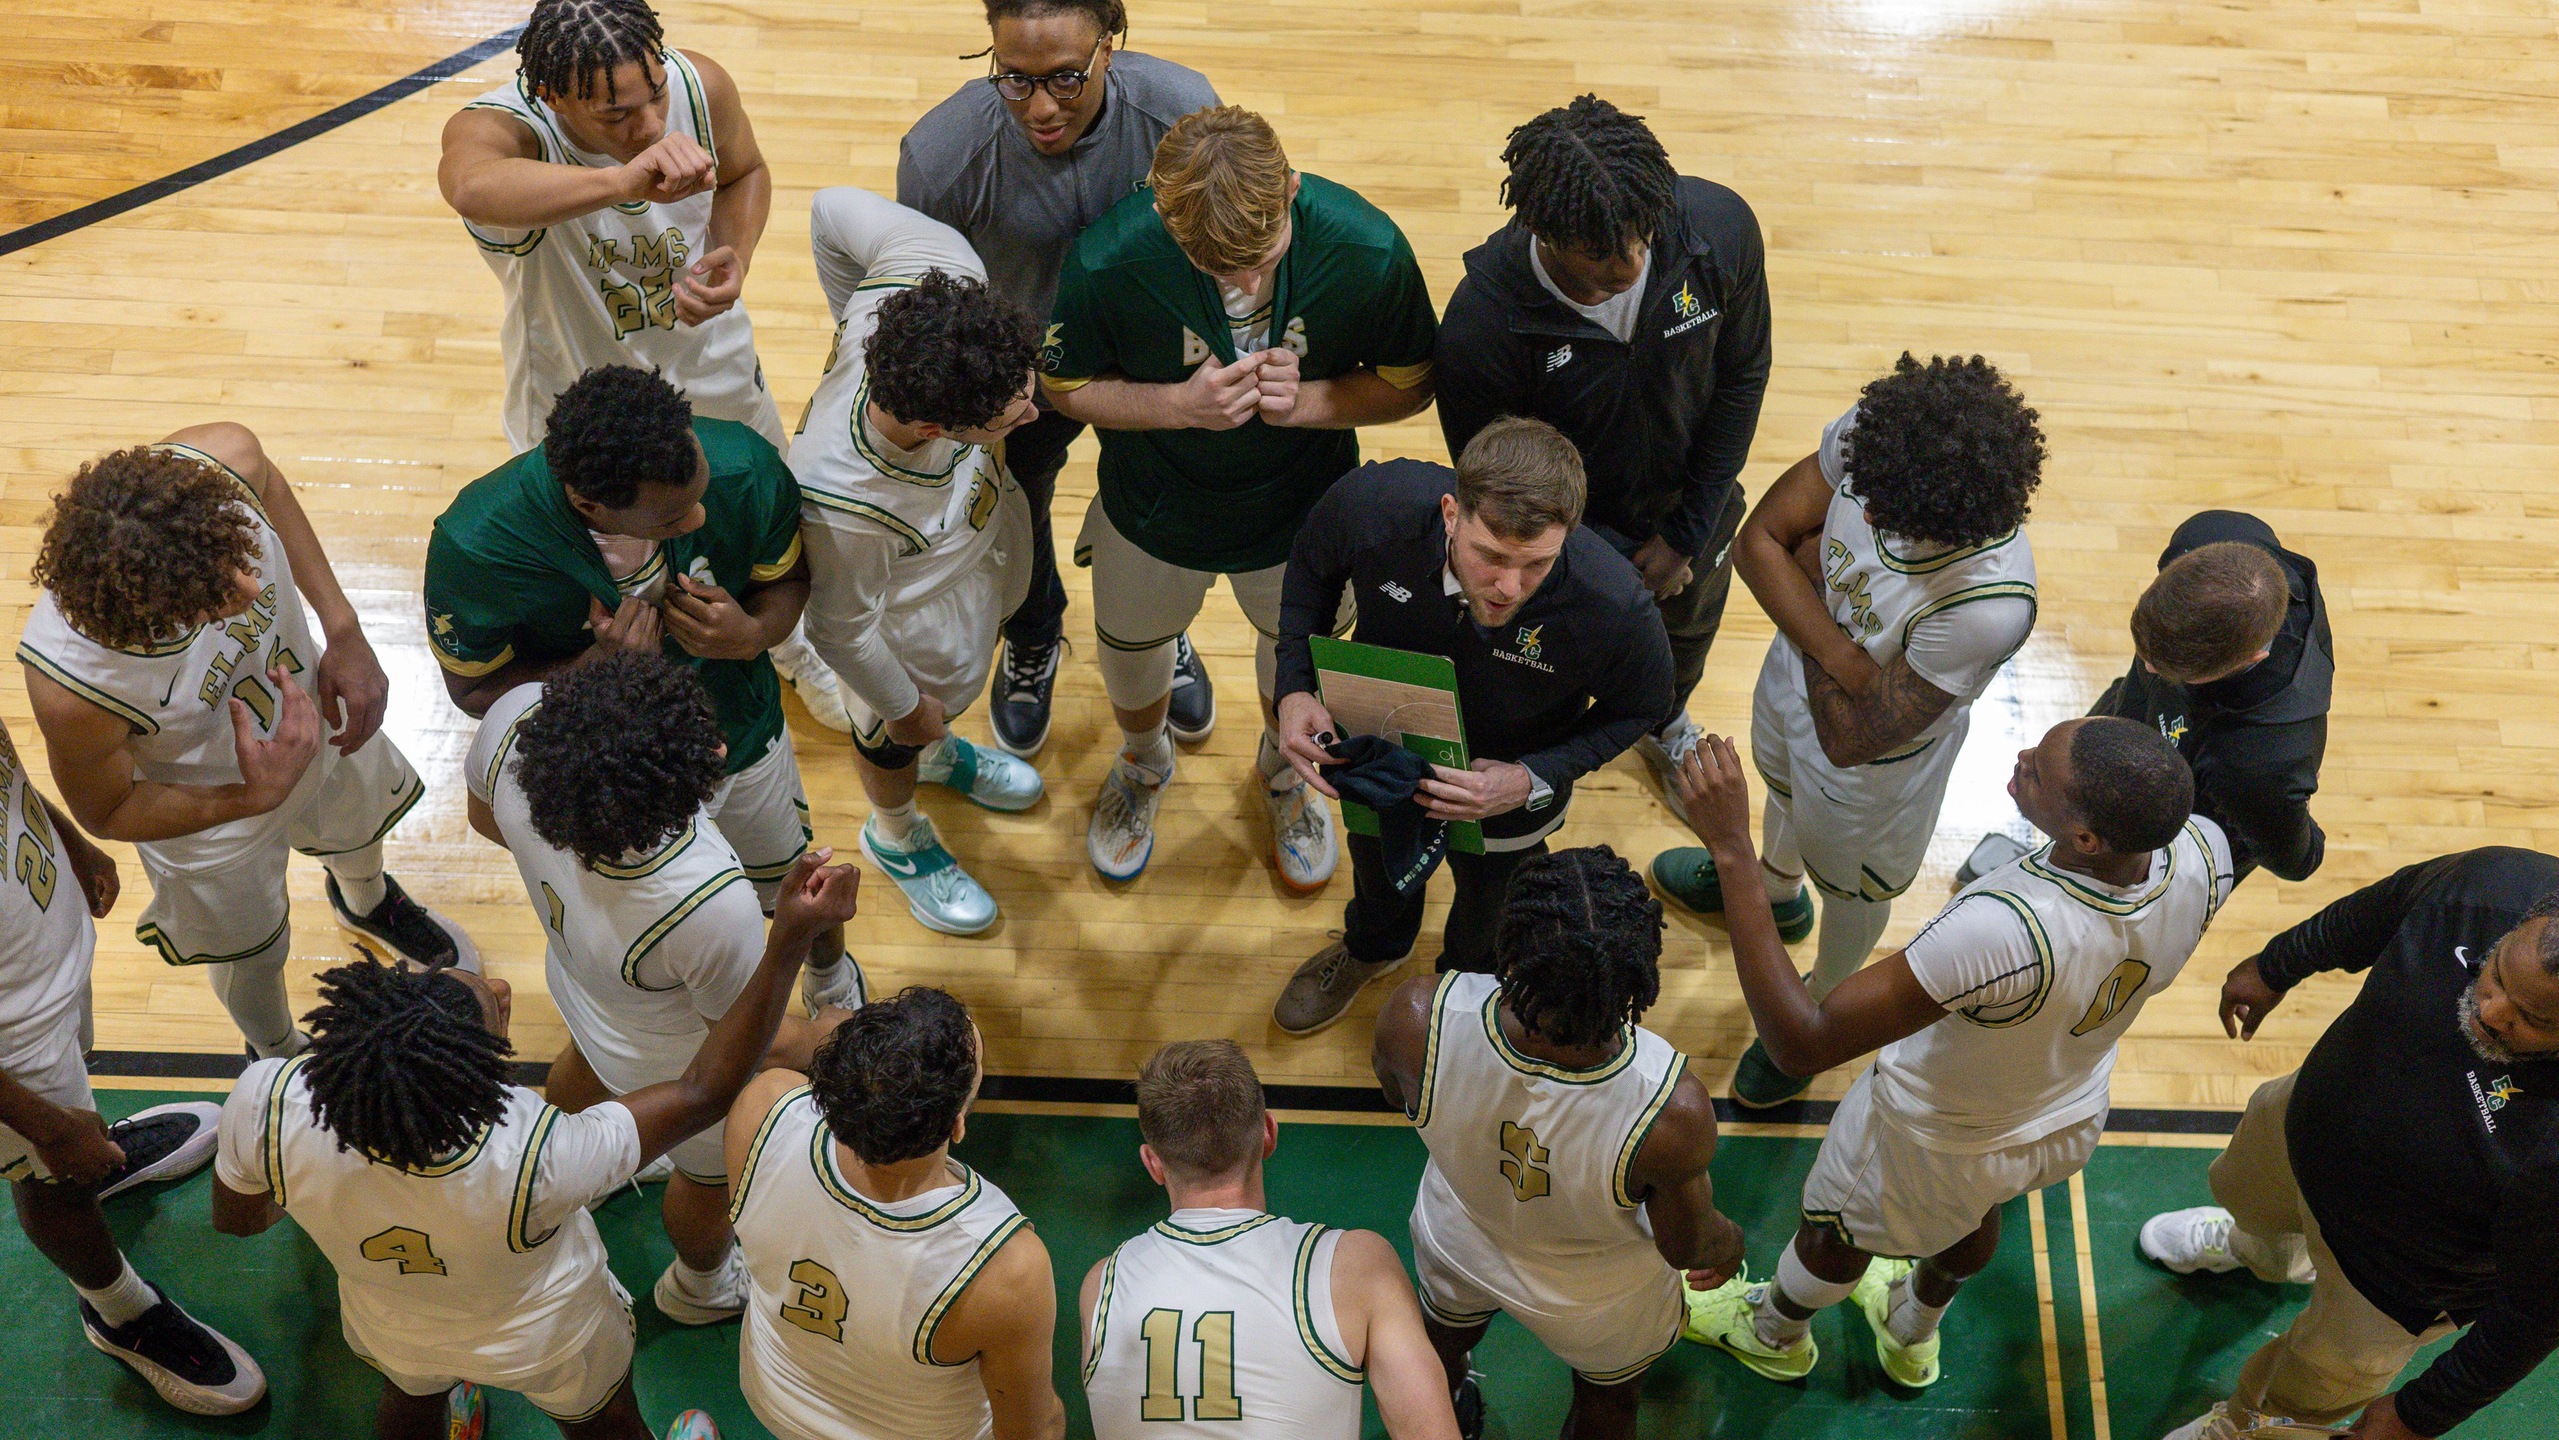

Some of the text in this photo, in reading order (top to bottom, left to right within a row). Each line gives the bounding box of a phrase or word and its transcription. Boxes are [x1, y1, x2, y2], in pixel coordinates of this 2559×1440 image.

[601, 268, 678, 341] 22
[1663, 308, 1718, 340] BASKETBALL
[1672, 286, 1700, 317] EC
[198, 583, 277, 711] ELMS
[1492, 648, 1555, 674] BASKETBALL
[1515, 624, 1543, 661] EC
[15, 781, 57, 914] 20
[2069, 958, 2152, 1037] 0
[2466, 1070, 2497, 1134] BASKETBALL
[2486, 1074, 2514, 1111] EC
[359, 1225, 448, 1277] 4
[780, 1258, 849, 1344] 3
[1140, 1307, 1242, 1422] 11
